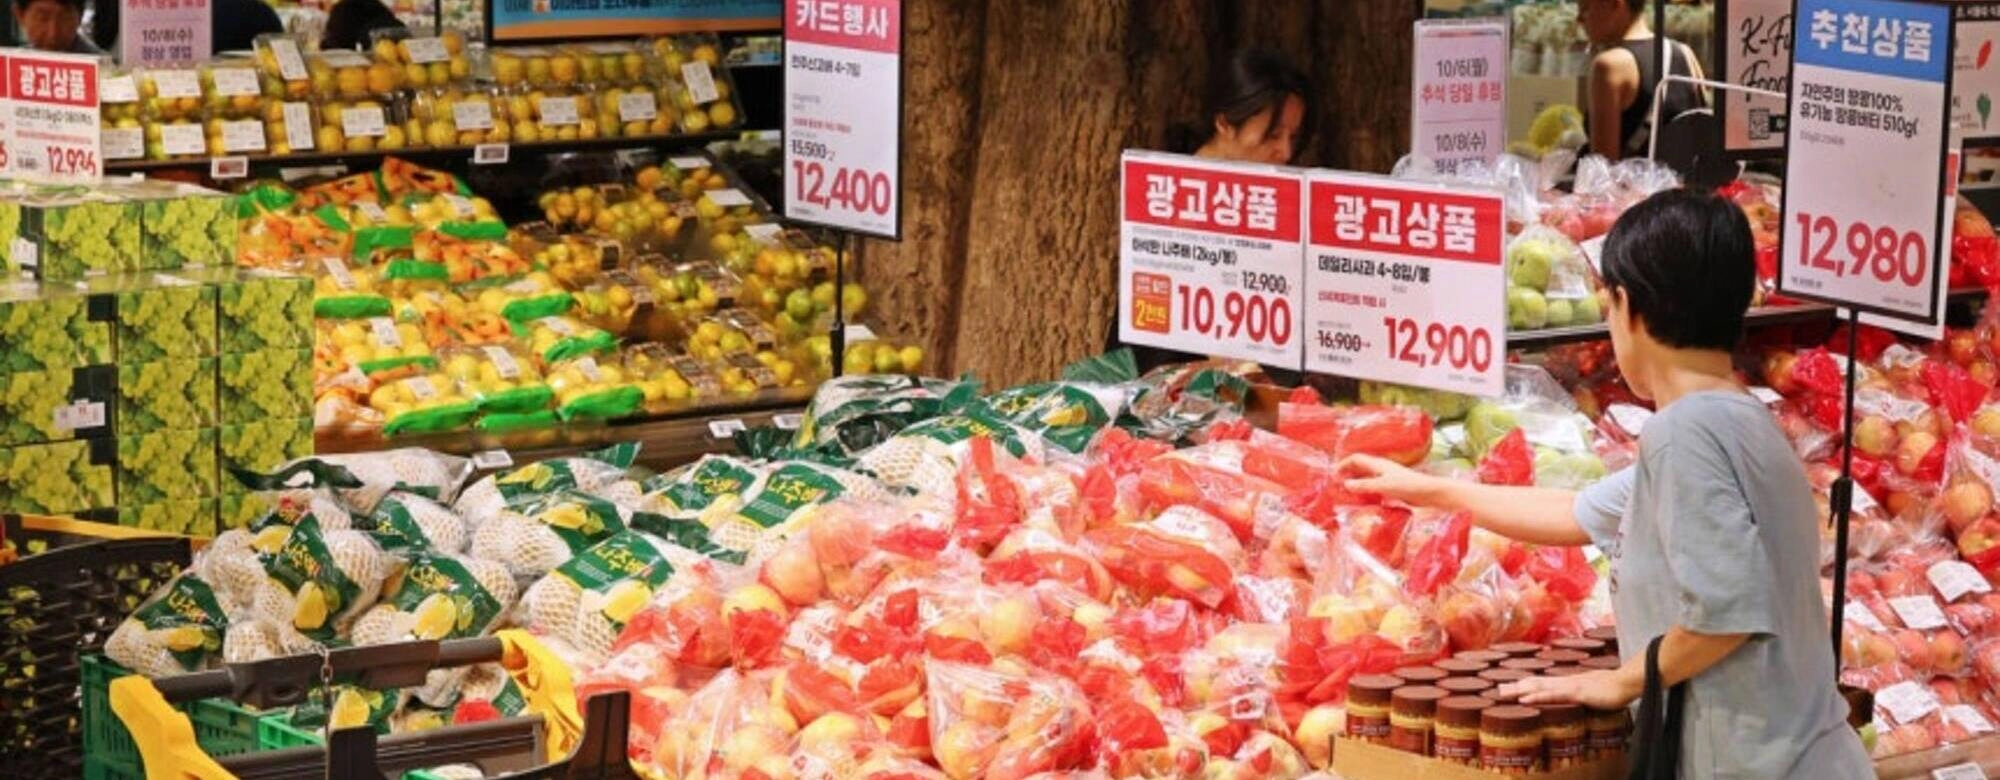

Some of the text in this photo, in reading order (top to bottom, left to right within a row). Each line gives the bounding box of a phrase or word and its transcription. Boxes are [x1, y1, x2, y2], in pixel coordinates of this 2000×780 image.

[796, 0, 889, 39] 카드행사
[1811, 9, 1933, 62] 추천상품
[20, 64, 86, 101] 광고상품
[1423, 84, 1446, 105] 추석
[1450, 83, 1473, 104] 당일
[1801, 82, 1845, 105] 자연주의
[1435, 130, 1487, 153] 10/8(수)
[793, 160, 890, 216] 12,400
[1146, 173, 1278, 231] 광고상품
[1334, 194, 1476, 254] 광고상품
[1319, 255, 1375, 276] 데일리사과
[1796, 212, 1926, 287] 12,980
[1242, 271, 1287, 294] 12,900
[1178, 285, 1291, 346] 10,900
[1383, 316, 1492, 373] 12,900
